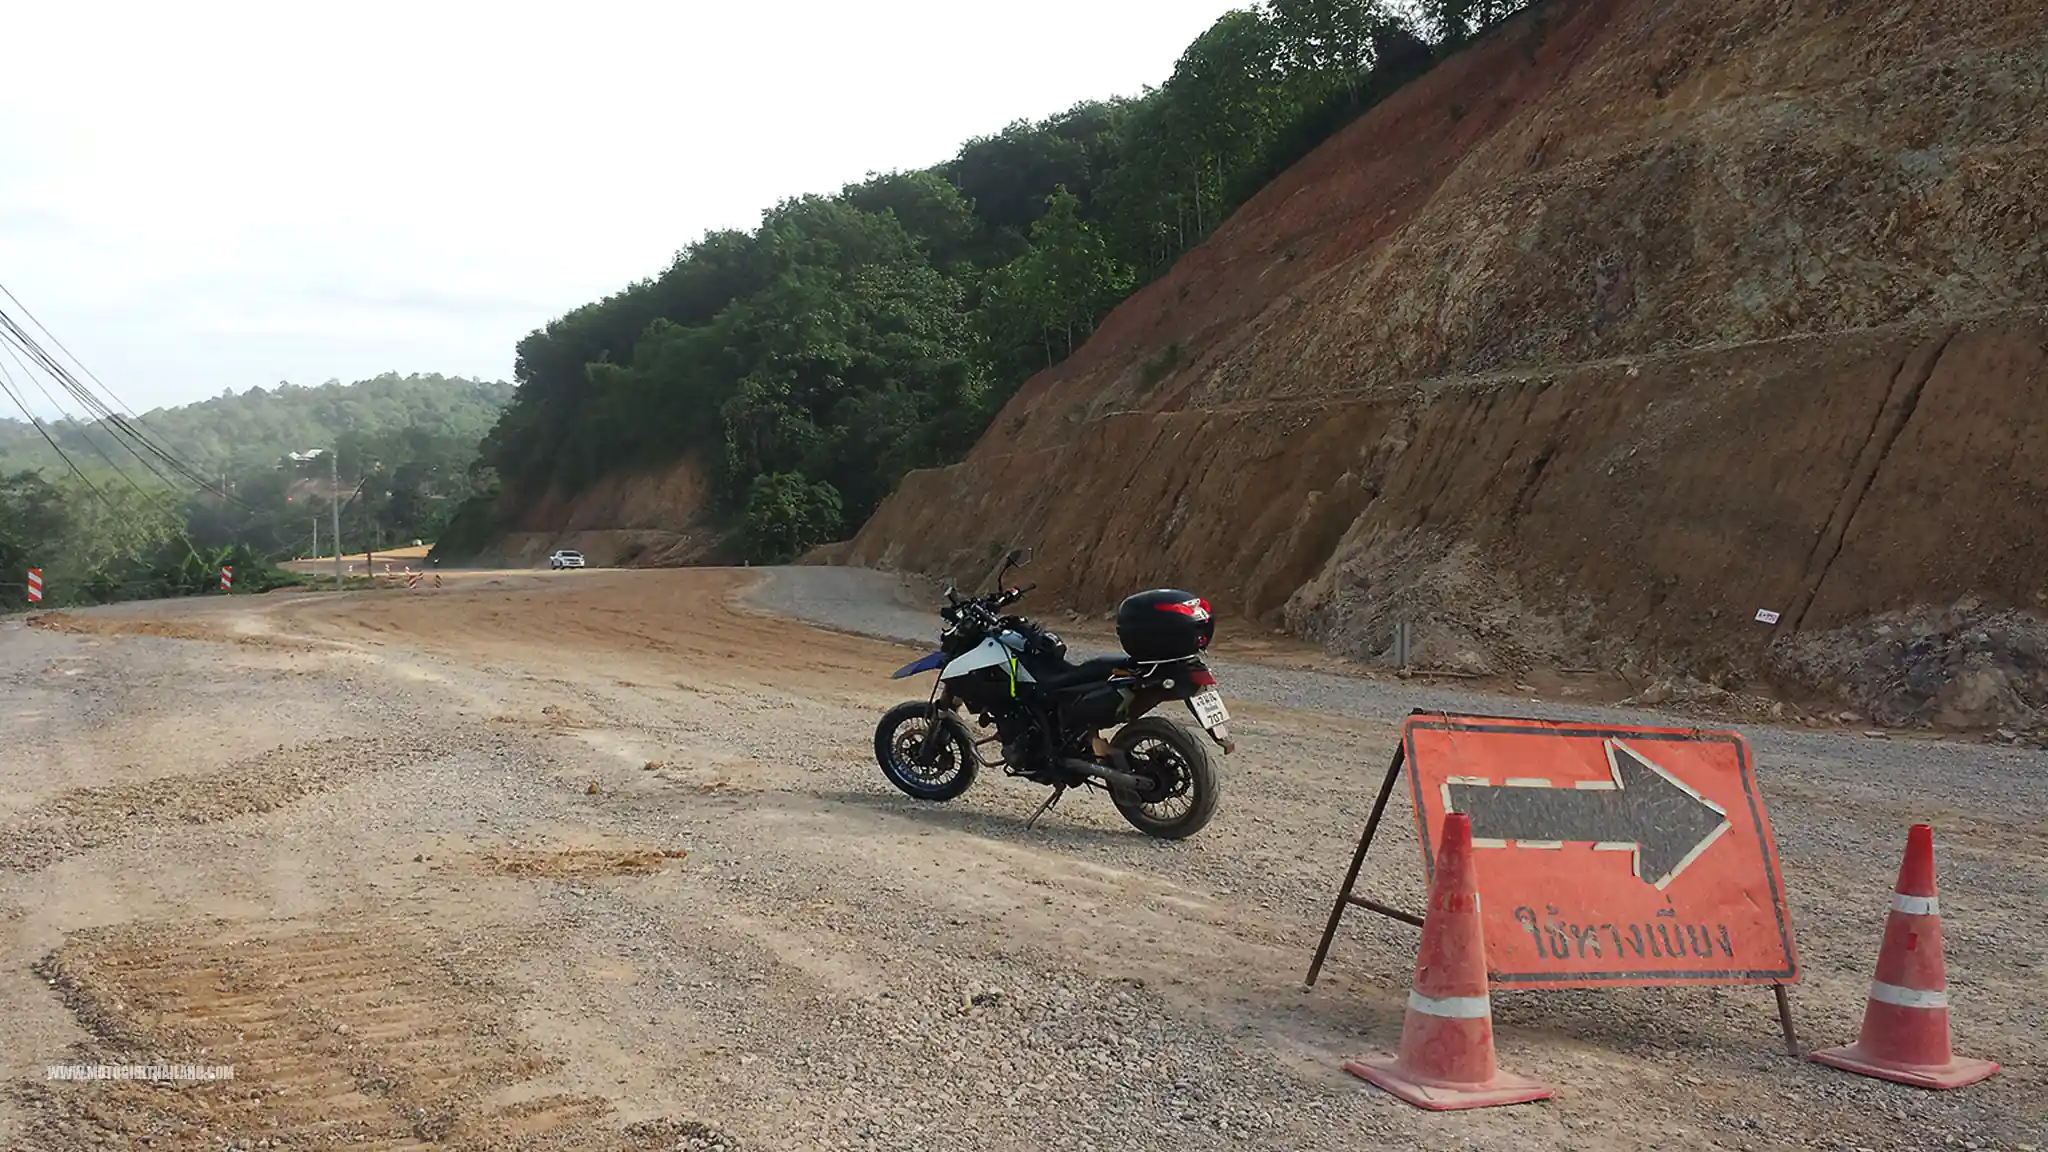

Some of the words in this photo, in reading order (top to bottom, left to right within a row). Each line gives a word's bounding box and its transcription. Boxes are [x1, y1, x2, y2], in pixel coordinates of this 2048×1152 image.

[1207, 711, 1224, 724] 707
[1514, 893, 1734, 960] ใช้ทางเบี่ยง
